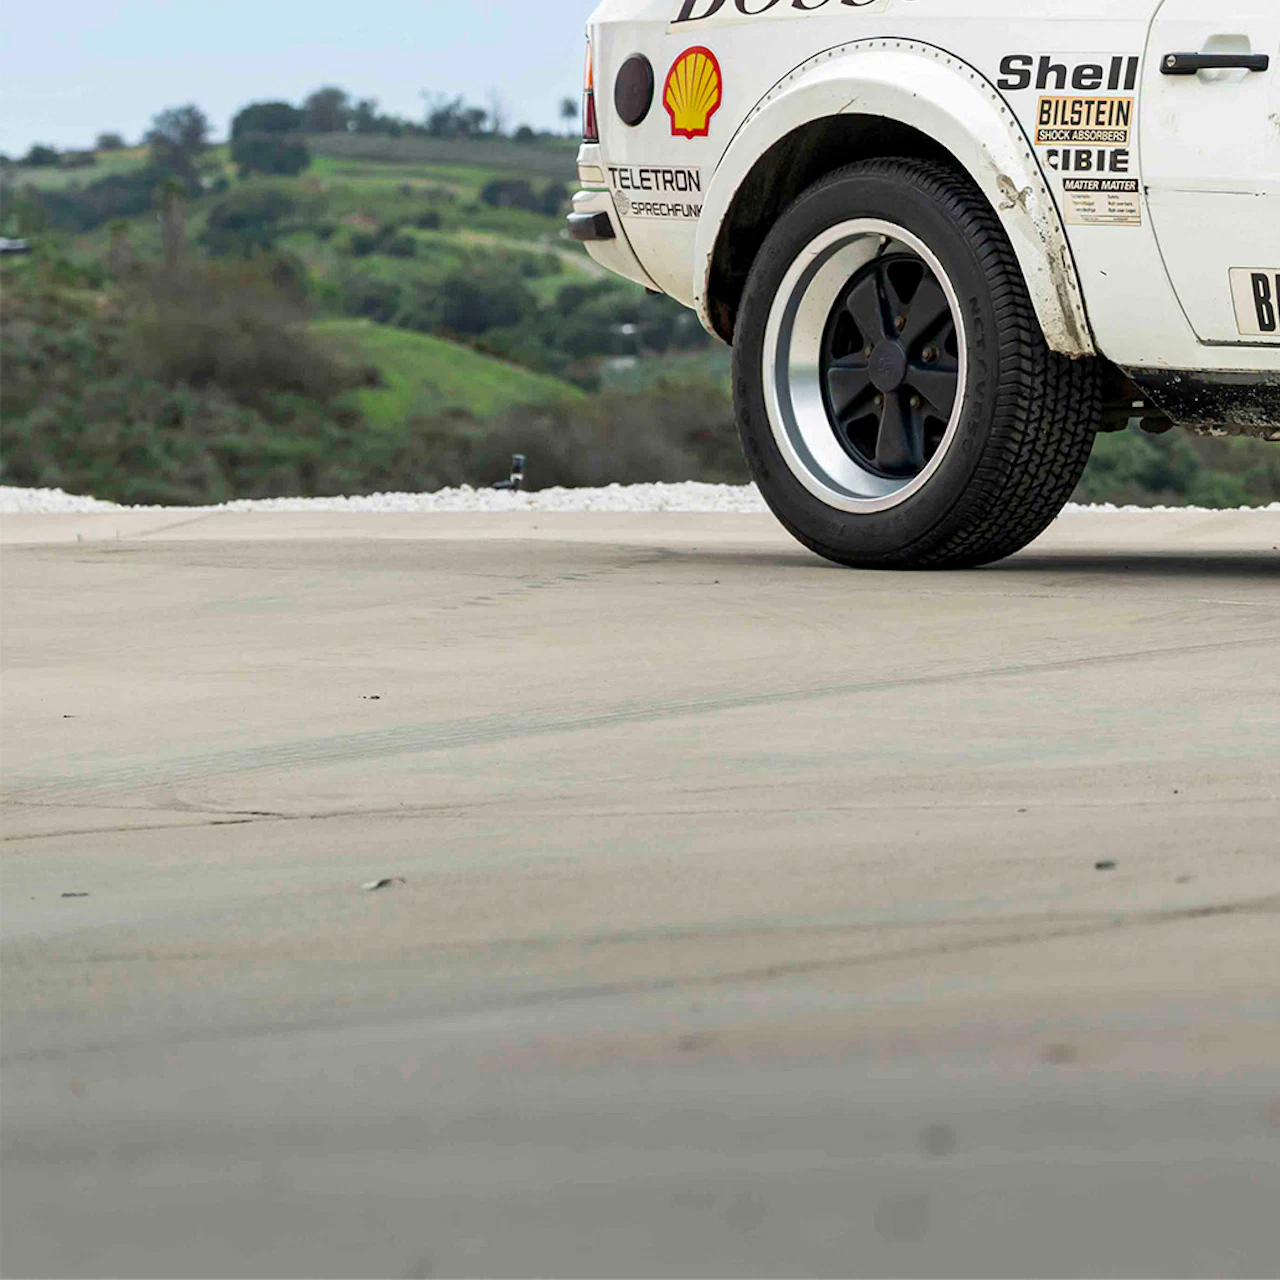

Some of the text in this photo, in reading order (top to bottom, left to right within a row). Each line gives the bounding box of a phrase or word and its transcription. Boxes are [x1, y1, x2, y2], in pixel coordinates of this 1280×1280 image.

[997, 54, 1139, 91] Shell
[1039, 99, 1131, 127] BILSTEIN
[1038, 130, 1125, 142] SHOCK ABSORBERS
[608, 167, 701, 192] TELETRON
[1064, 179, 1137, 190] MATTER MATTER
